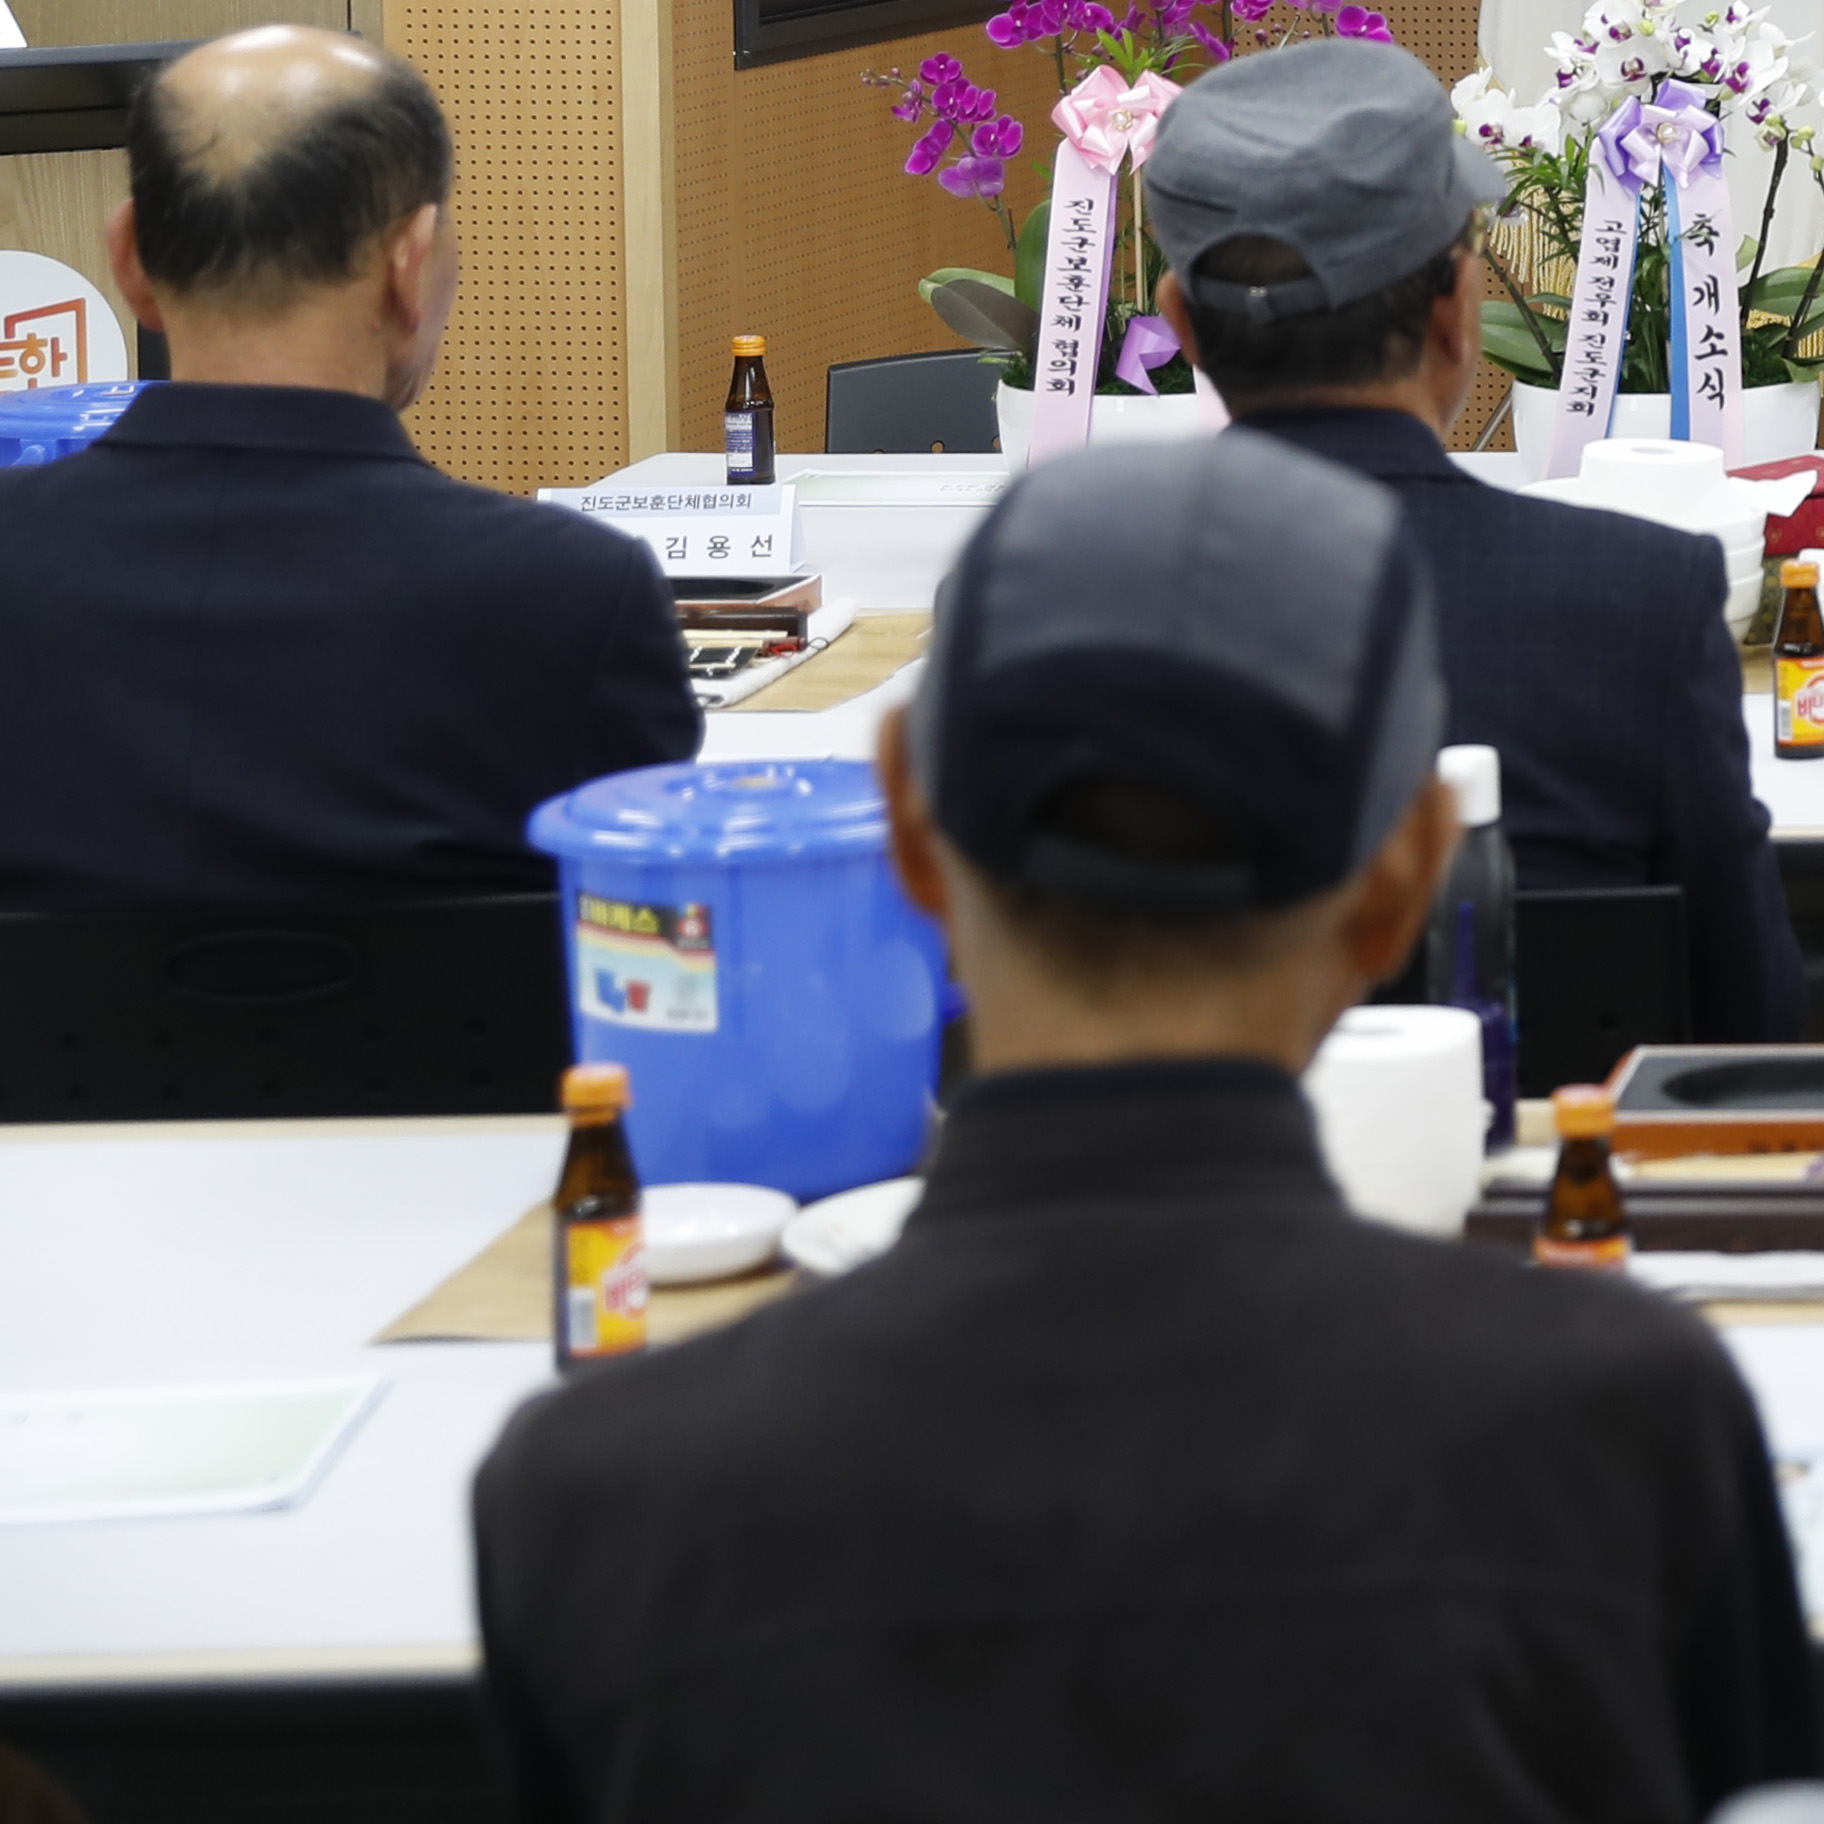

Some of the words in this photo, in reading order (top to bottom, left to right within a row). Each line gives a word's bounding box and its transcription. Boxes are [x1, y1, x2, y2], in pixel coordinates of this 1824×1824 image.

[1687, 212, 1721, 257] 축
[1581, 275, 1617, 327] 전우회
[1045, 339, 1081, 397] 협의회
[1692, 274, 1729, 412] 개소식
[1565, 332, 1608, 417] 진도군지회
[579, 492, 753, 512] 진도군보훈단체협의회
